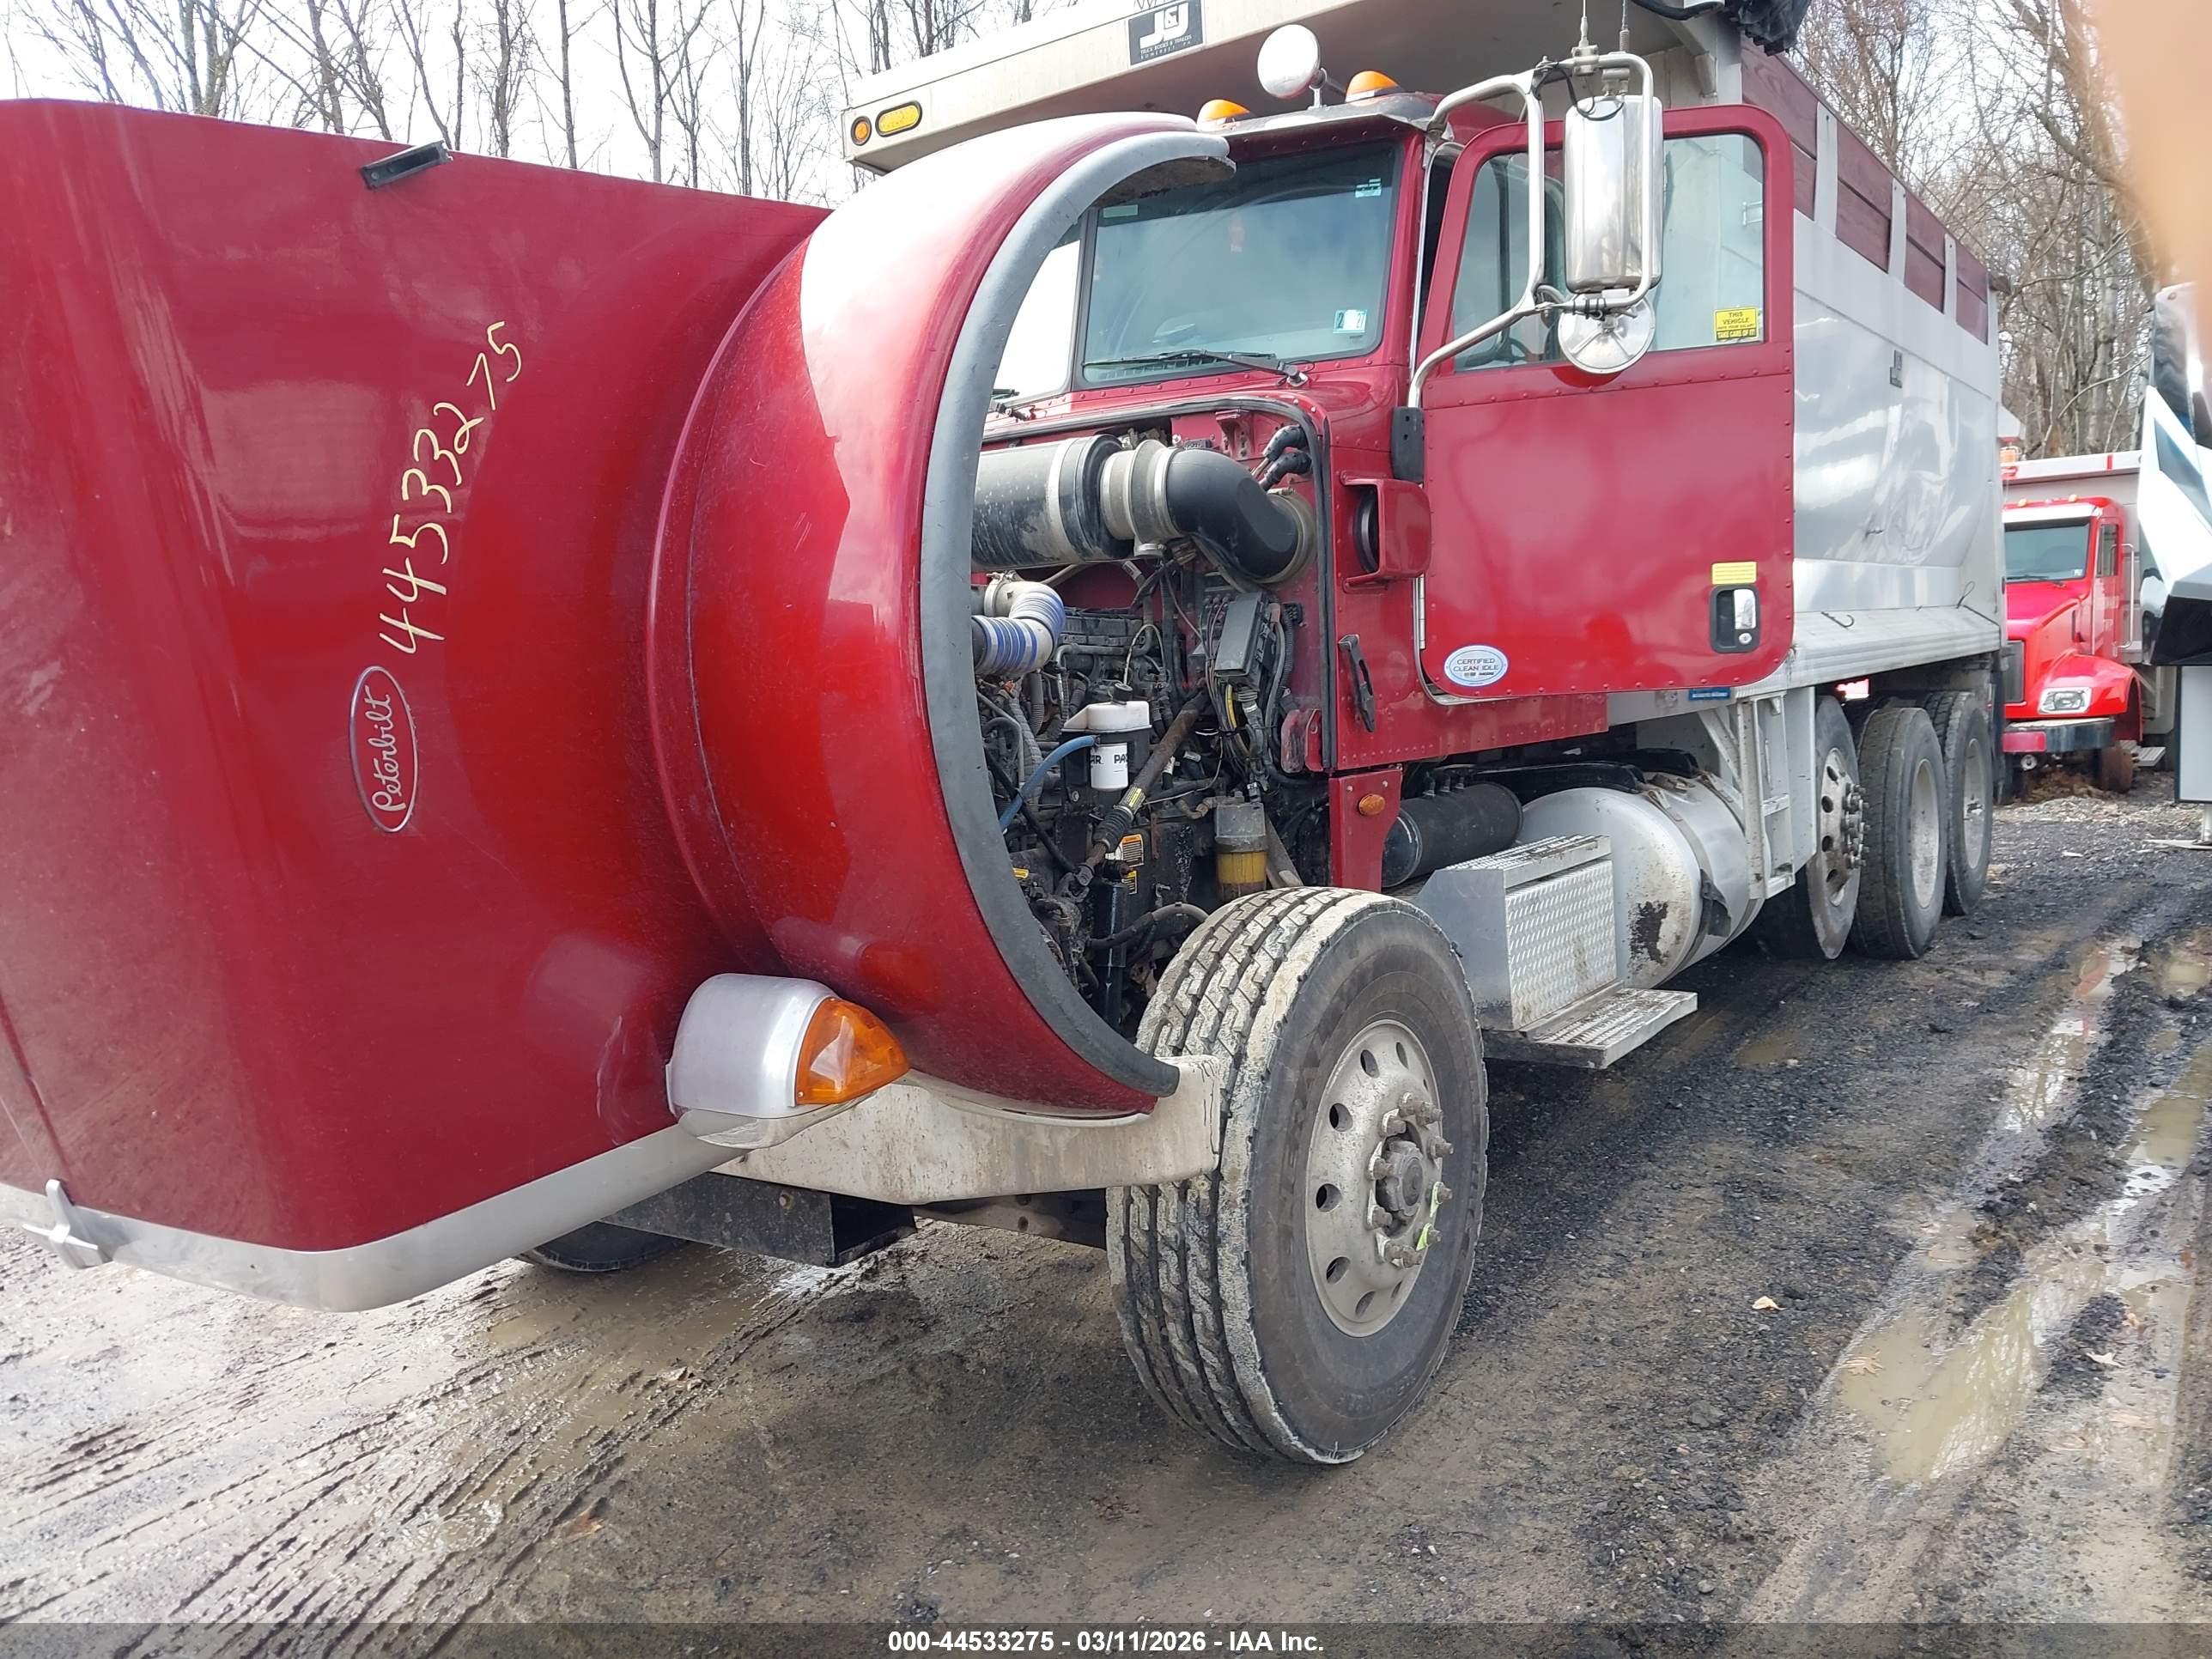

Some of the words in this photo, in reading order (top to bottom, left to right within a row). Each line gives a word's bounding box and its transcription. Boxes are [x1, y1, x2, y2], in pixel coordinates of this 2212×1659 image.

[1723, 317, 1750, 325] VEHICLE
[379, 320, 522, 654] 44533275
[364, 684, 407, 812] Peterbilt
